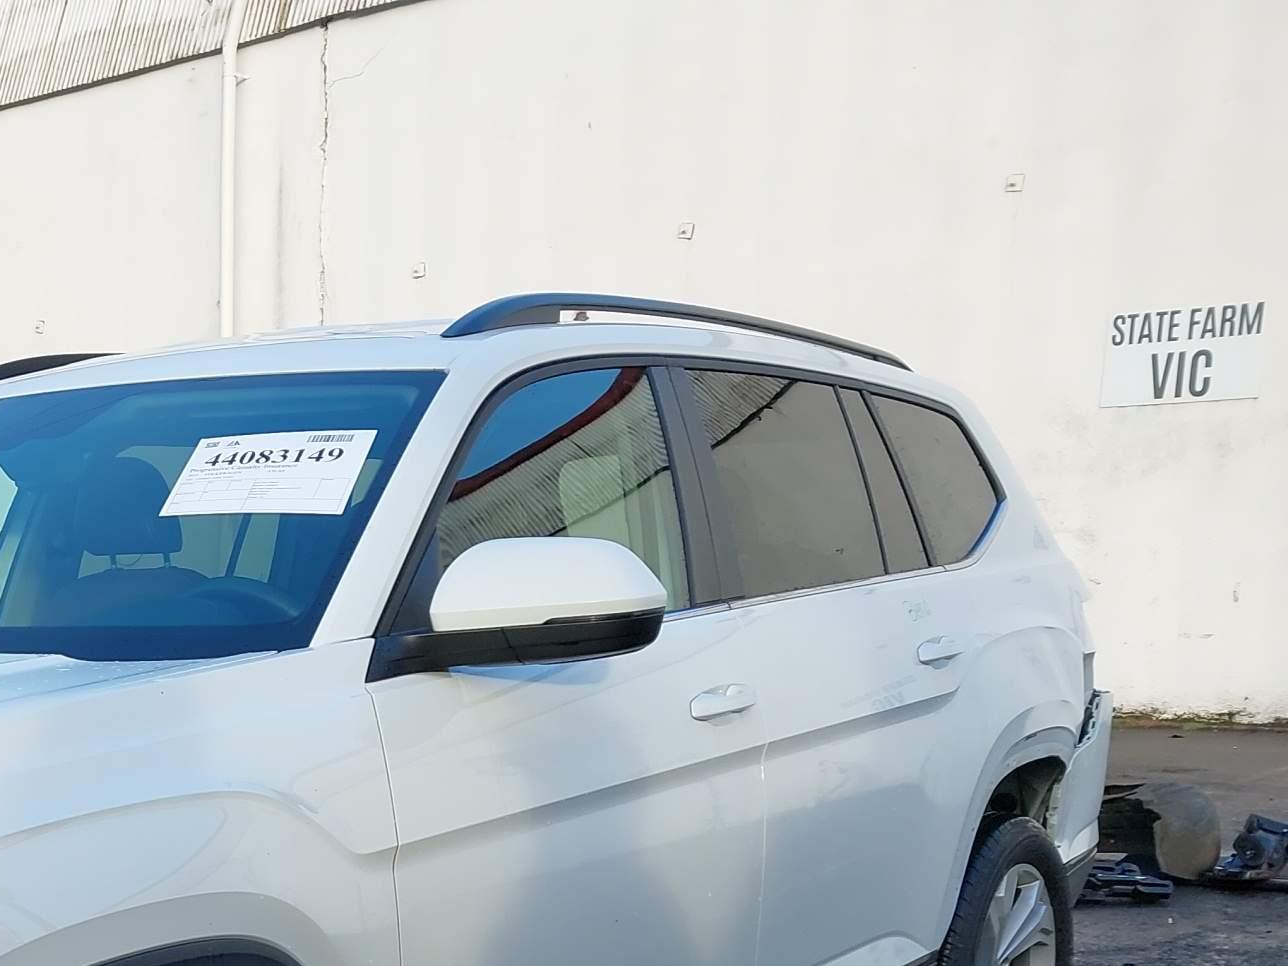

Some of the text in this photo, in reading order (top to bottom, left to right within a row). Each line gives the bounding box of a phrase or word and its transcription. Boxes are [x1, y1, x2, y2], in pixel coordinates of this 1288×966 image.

[1112, 301, 1265, 346] STATE FARM
[1151, 348, 1213, 400] VIC
[205, 447, 345, 467] 44083149
